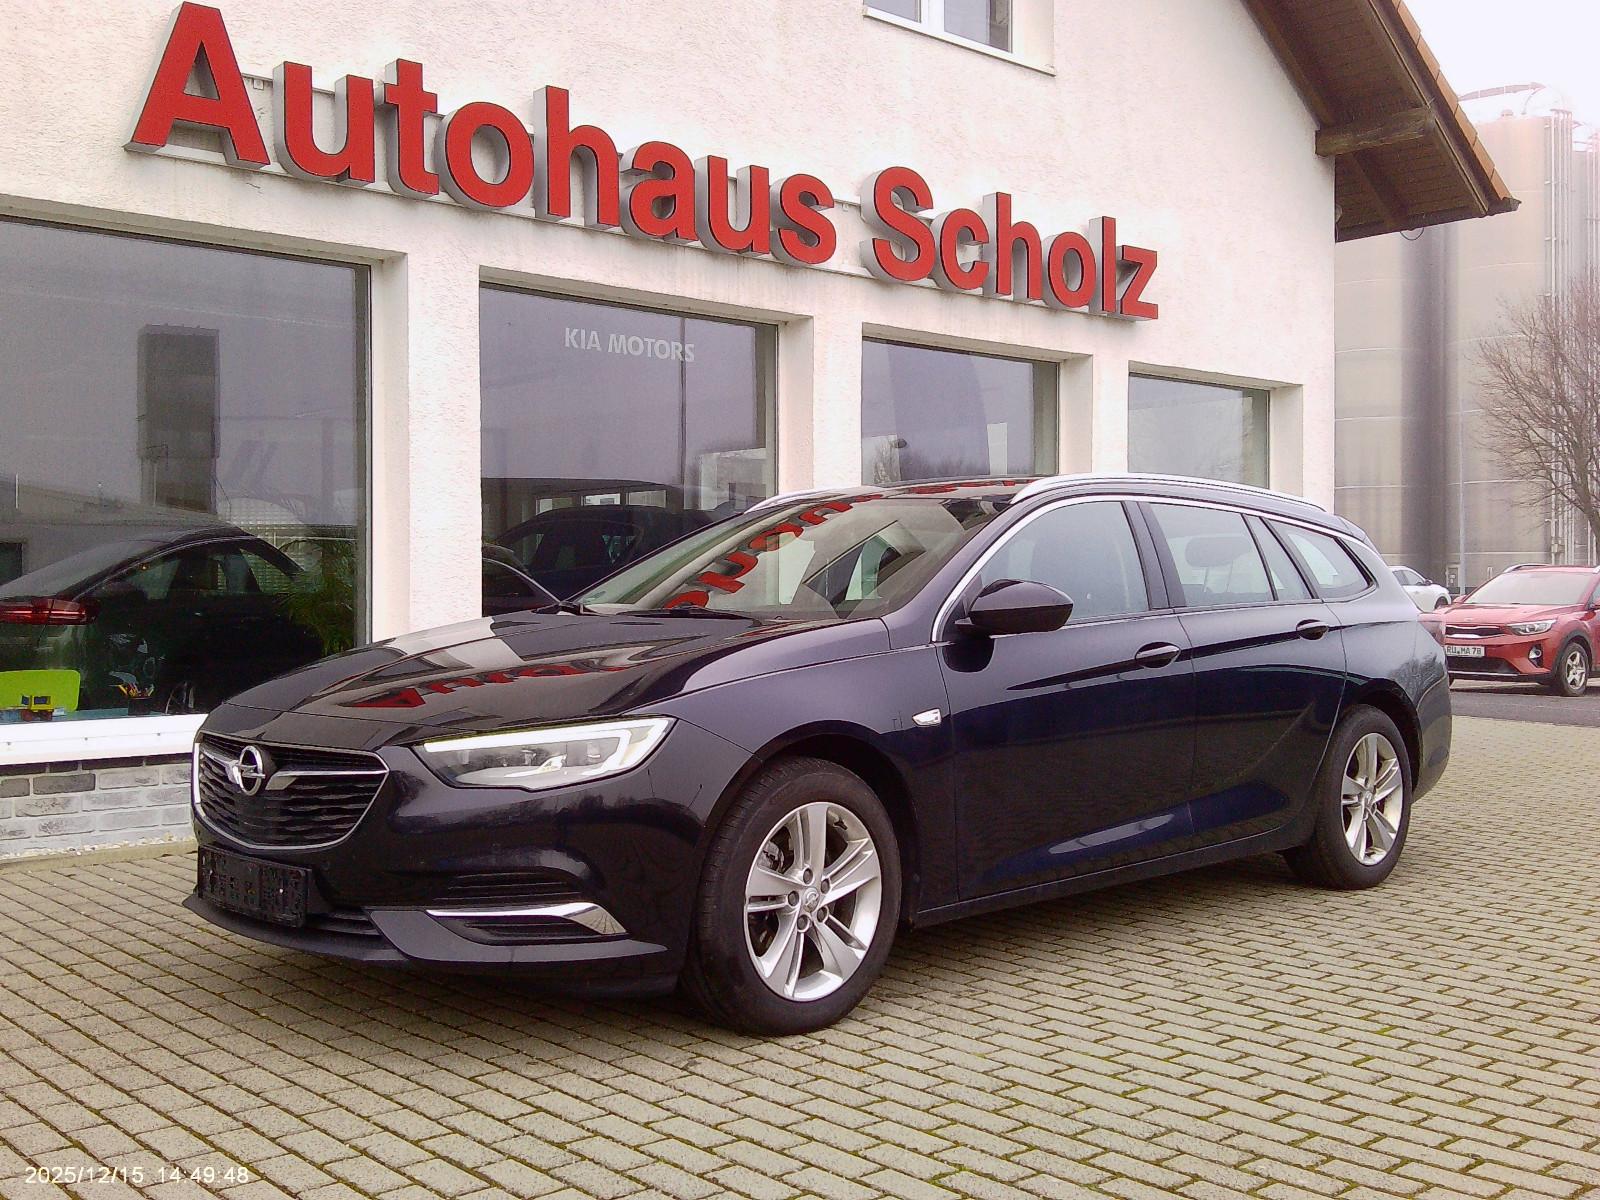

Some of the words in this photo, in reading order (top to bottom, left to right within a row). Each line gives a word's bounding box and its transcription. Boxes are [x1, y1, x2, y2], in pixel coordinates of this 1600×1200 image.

[128, 1, 837, 265] Autohaus
[866, 166, 1158, 320] Scholz
[564, 327, 602, 352] KIA
[607, 333, 696, 362] MOTORS
